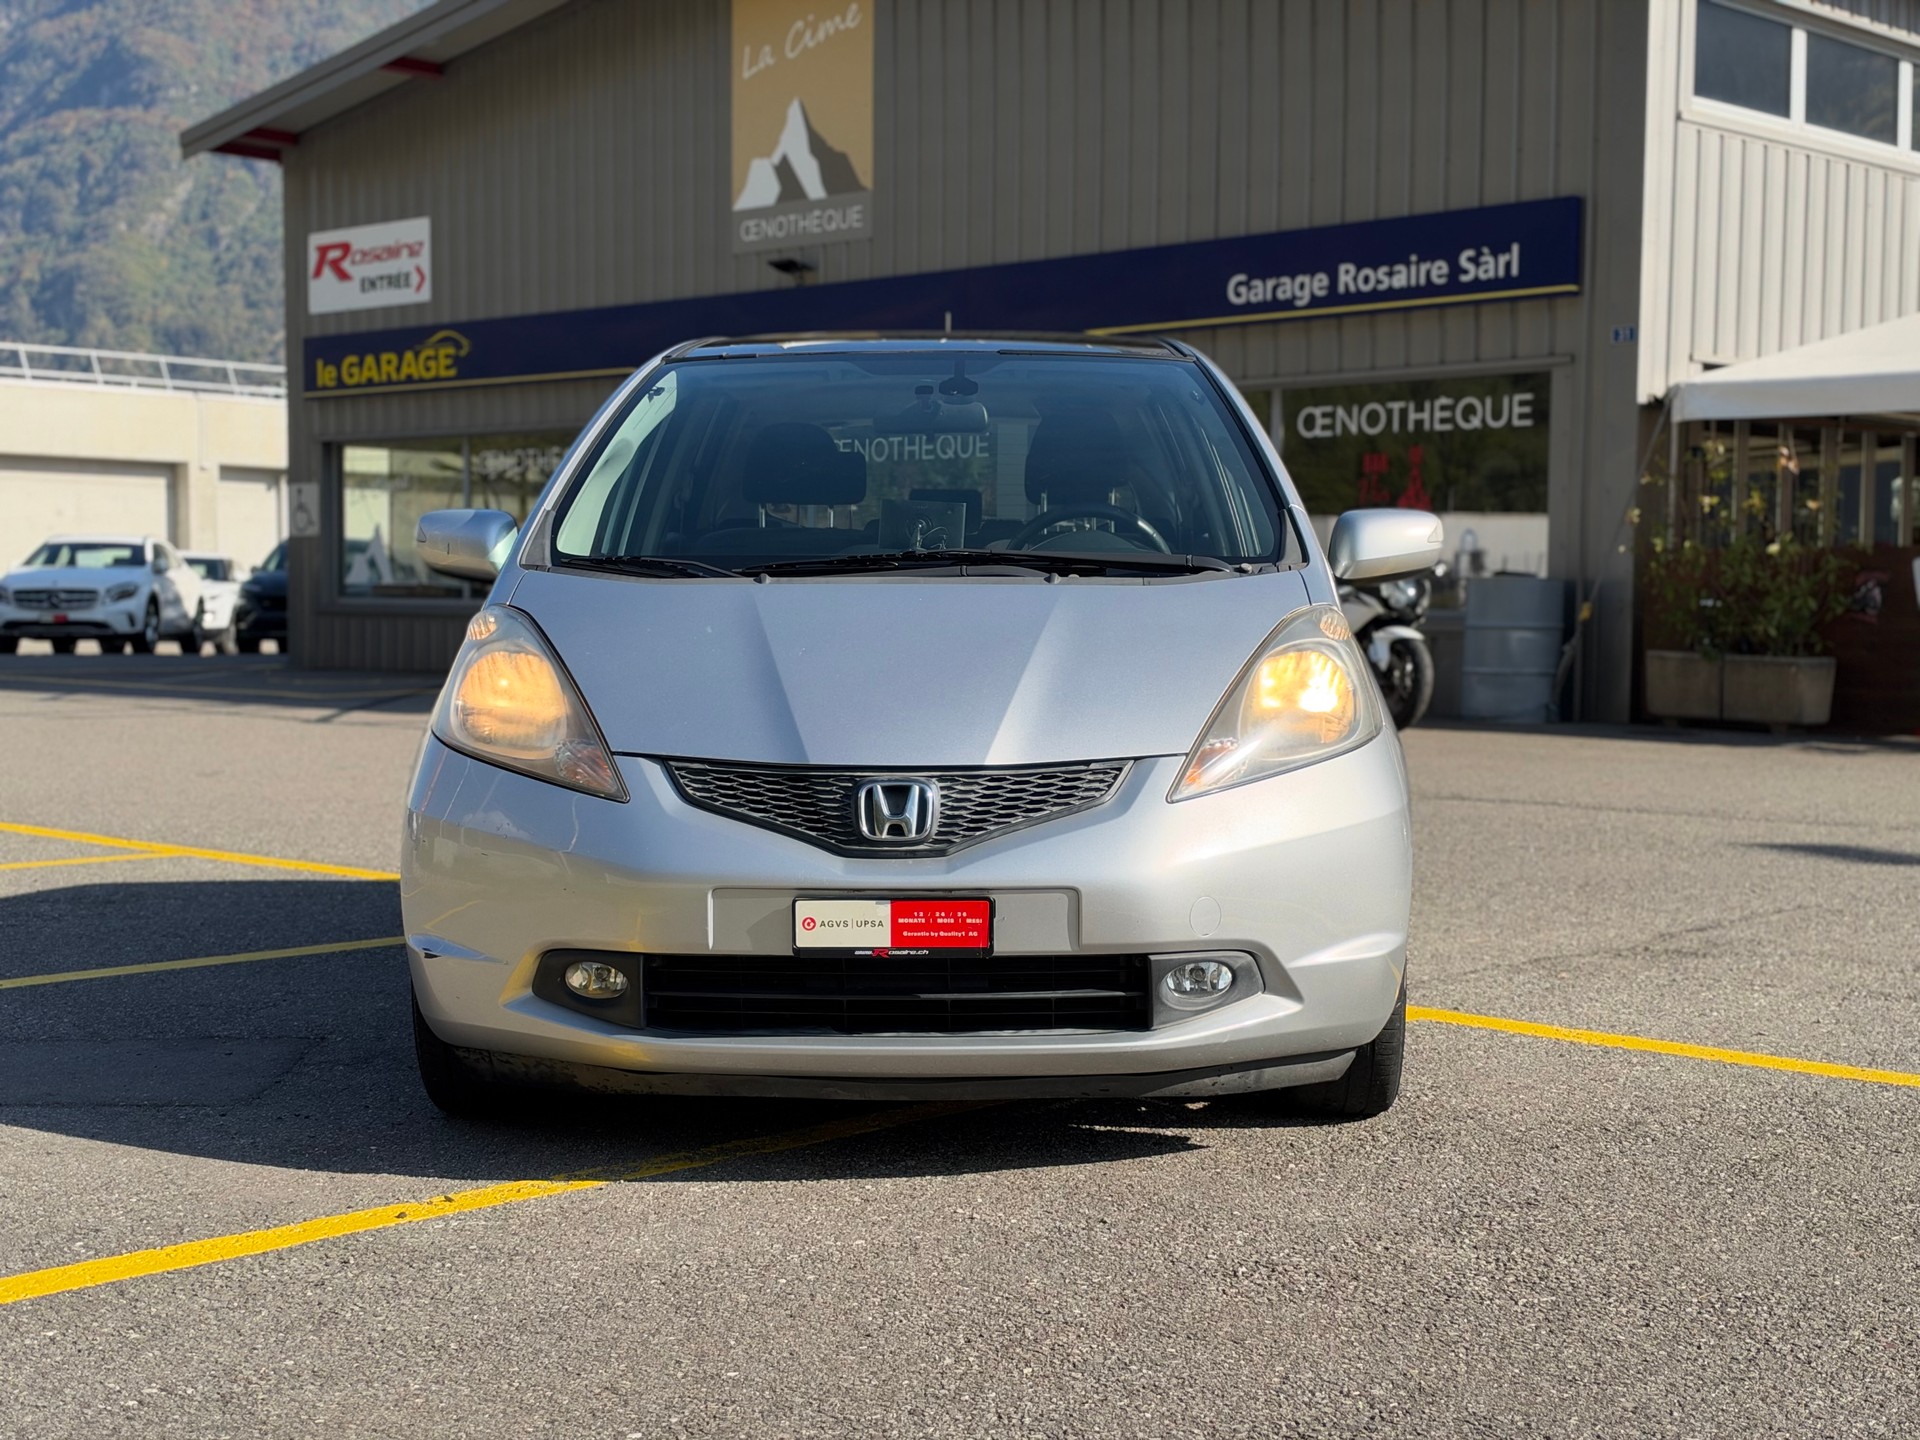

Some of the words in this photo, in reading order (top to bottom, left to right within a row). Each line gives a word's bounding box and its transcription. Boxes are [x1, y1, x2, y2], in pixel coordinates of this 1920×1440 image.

[742, 45, 775, 80] La
[784, 3, 863, 59] Cime
[1226, 272, 1329, 307] Garage
[1338, 254, 1449, 294] Rosaire
[1458, 242, 1520, 283] Sàrl
[315, 357, 338, 388] le
[340, 346, 458, 386] GARAGE
[819, 919, 849, 929] AGVS
[856, 919, 884, 929] UPSA
